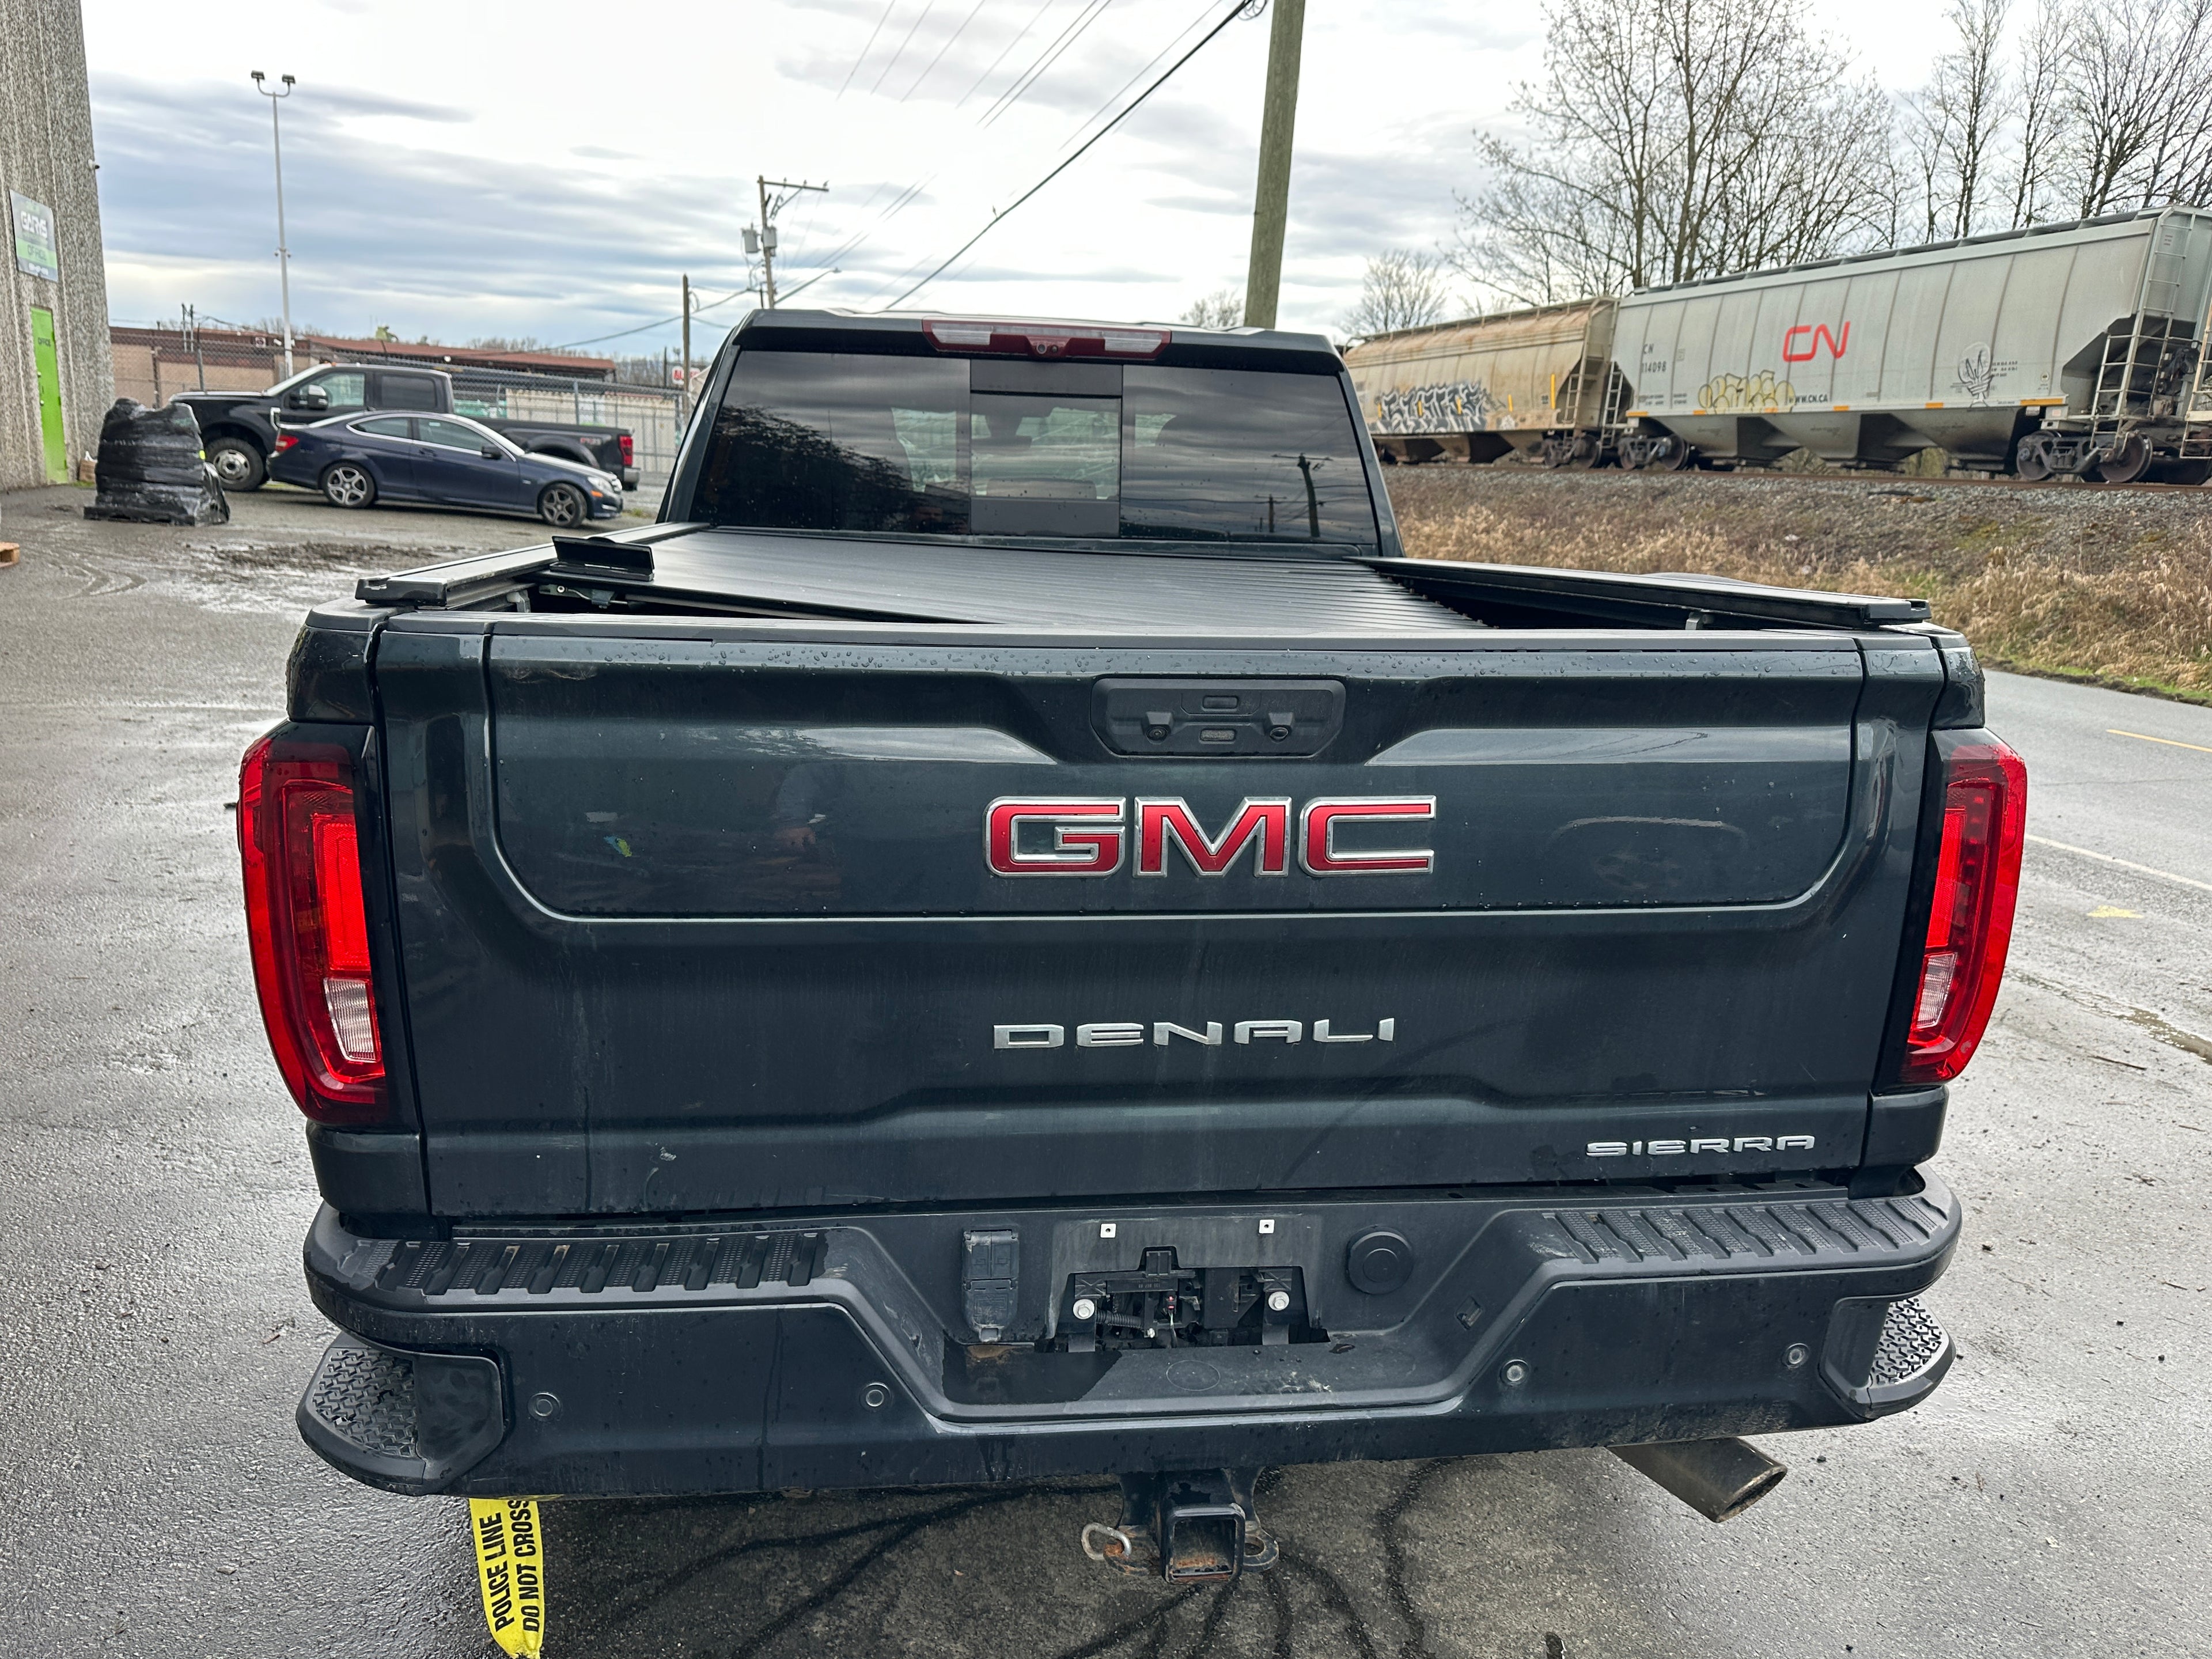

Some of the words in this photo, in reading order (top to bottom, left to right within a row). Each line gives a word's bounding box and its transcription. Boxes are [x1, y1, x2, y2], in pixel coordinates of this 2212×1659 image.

[1643, 343, 1654, 354] CN
[1782, 320, 1851, 363] CN
[986, 796, 1437, 878] GMC
[993, 1017, 1395, 1050] DENALI
[1586, 1135, 1815, 1157] SIERRA
[479, 1512, 506, 1560] LINE
[507, 1499, 536, 1558] CROSS
[487, 1560, 514, 1632] POLICE
[517, 1563, 540, 1600] NOT
[521, 1605, 540, 1633] DO
